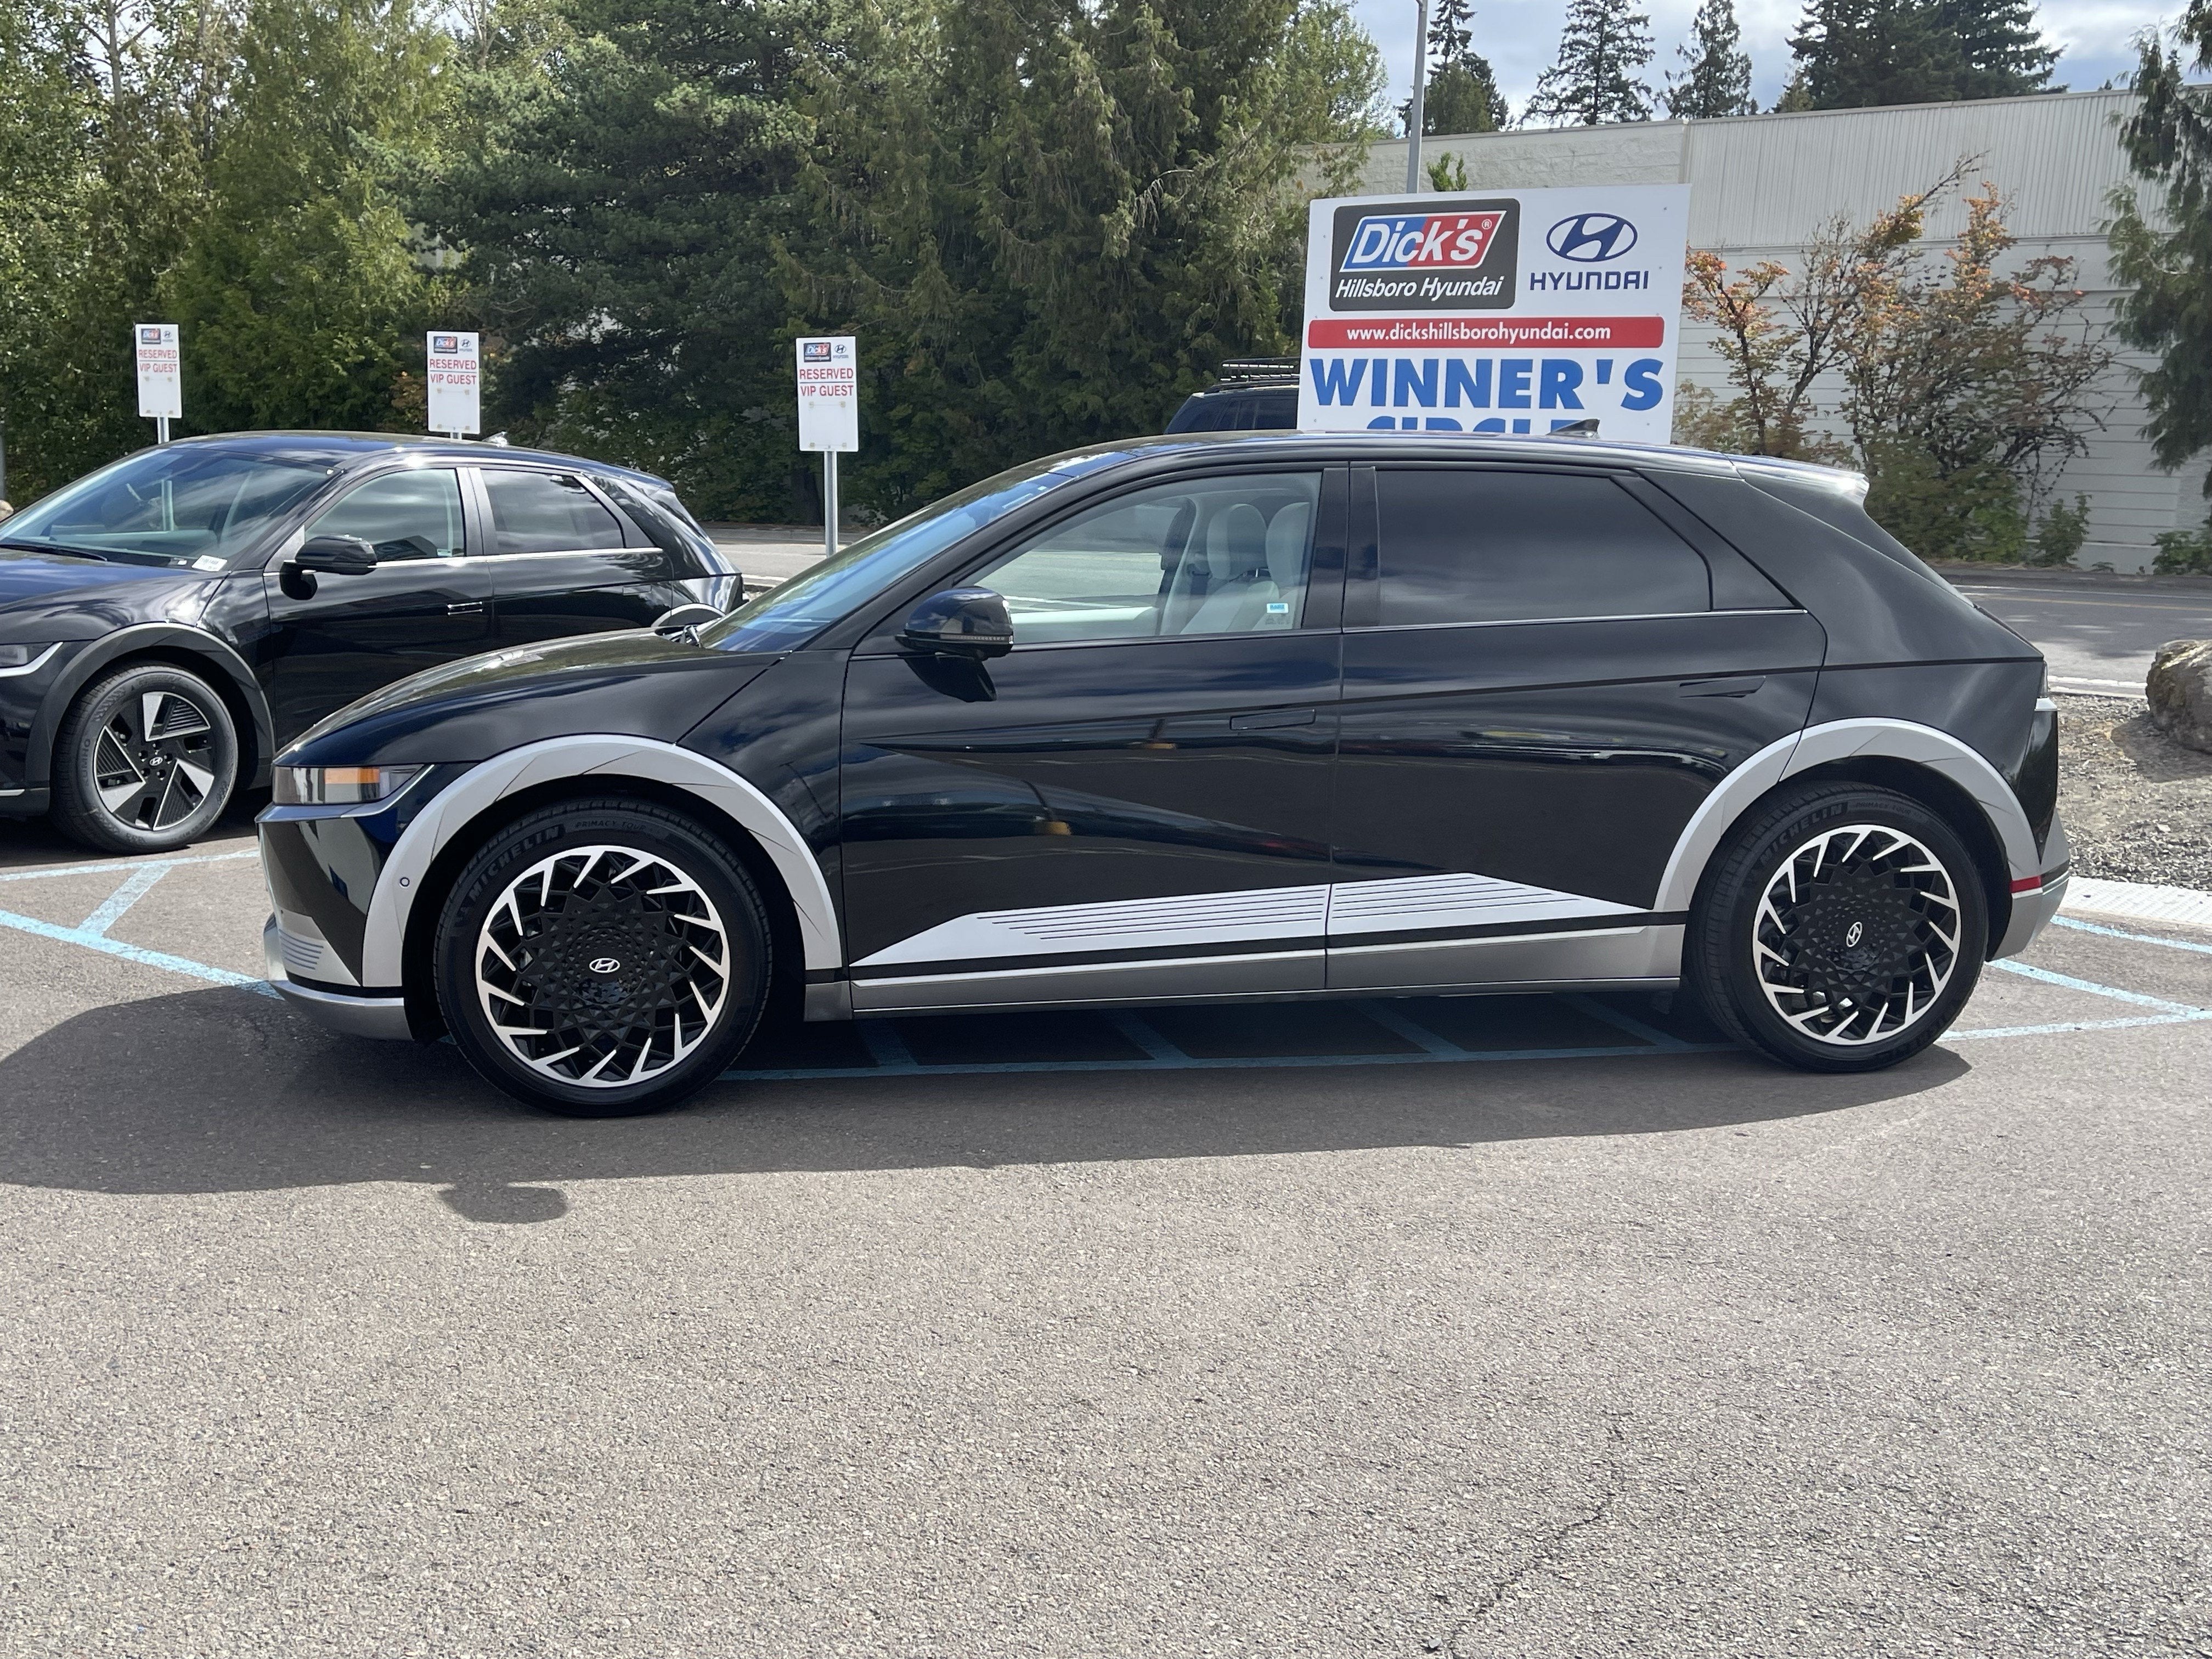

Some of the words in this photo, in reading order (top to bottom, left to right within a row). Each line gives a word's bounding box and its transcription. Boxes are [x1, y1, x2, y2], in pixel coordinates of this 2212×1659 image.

[1352, 221, 1485, 266] Dick's
[1335, 277, 1417, 298] Hillsboro
[1420, 276, 1504, 301] Hyundai
[1530, 270, 1649, 291] HYUNDAI
[1347, 321, 1611, 343] www.dickshillsborohyundai.com
[138, 349, 177, 359] RESERVED
[139, 363, 151, 372] VIP
[153, 363, 177, 373] GUEST
[430, 359, 477, 370] RESERVED
[430, 374, 444, 383] VIP
[447, 374, 476, 385] GUEST
[799, 368, 854, 380] RESERVED
[800, 386, 816, 396] VIP
[819, 385, 854, 396] GUEST
[1310, 358, 1664, 411] WINNER'S
[575, 820, 617, 828] PRIMACY
[1760, 804, 1842, 866] MICHELIN
[469, 826, 560, 901] MICHELIN
